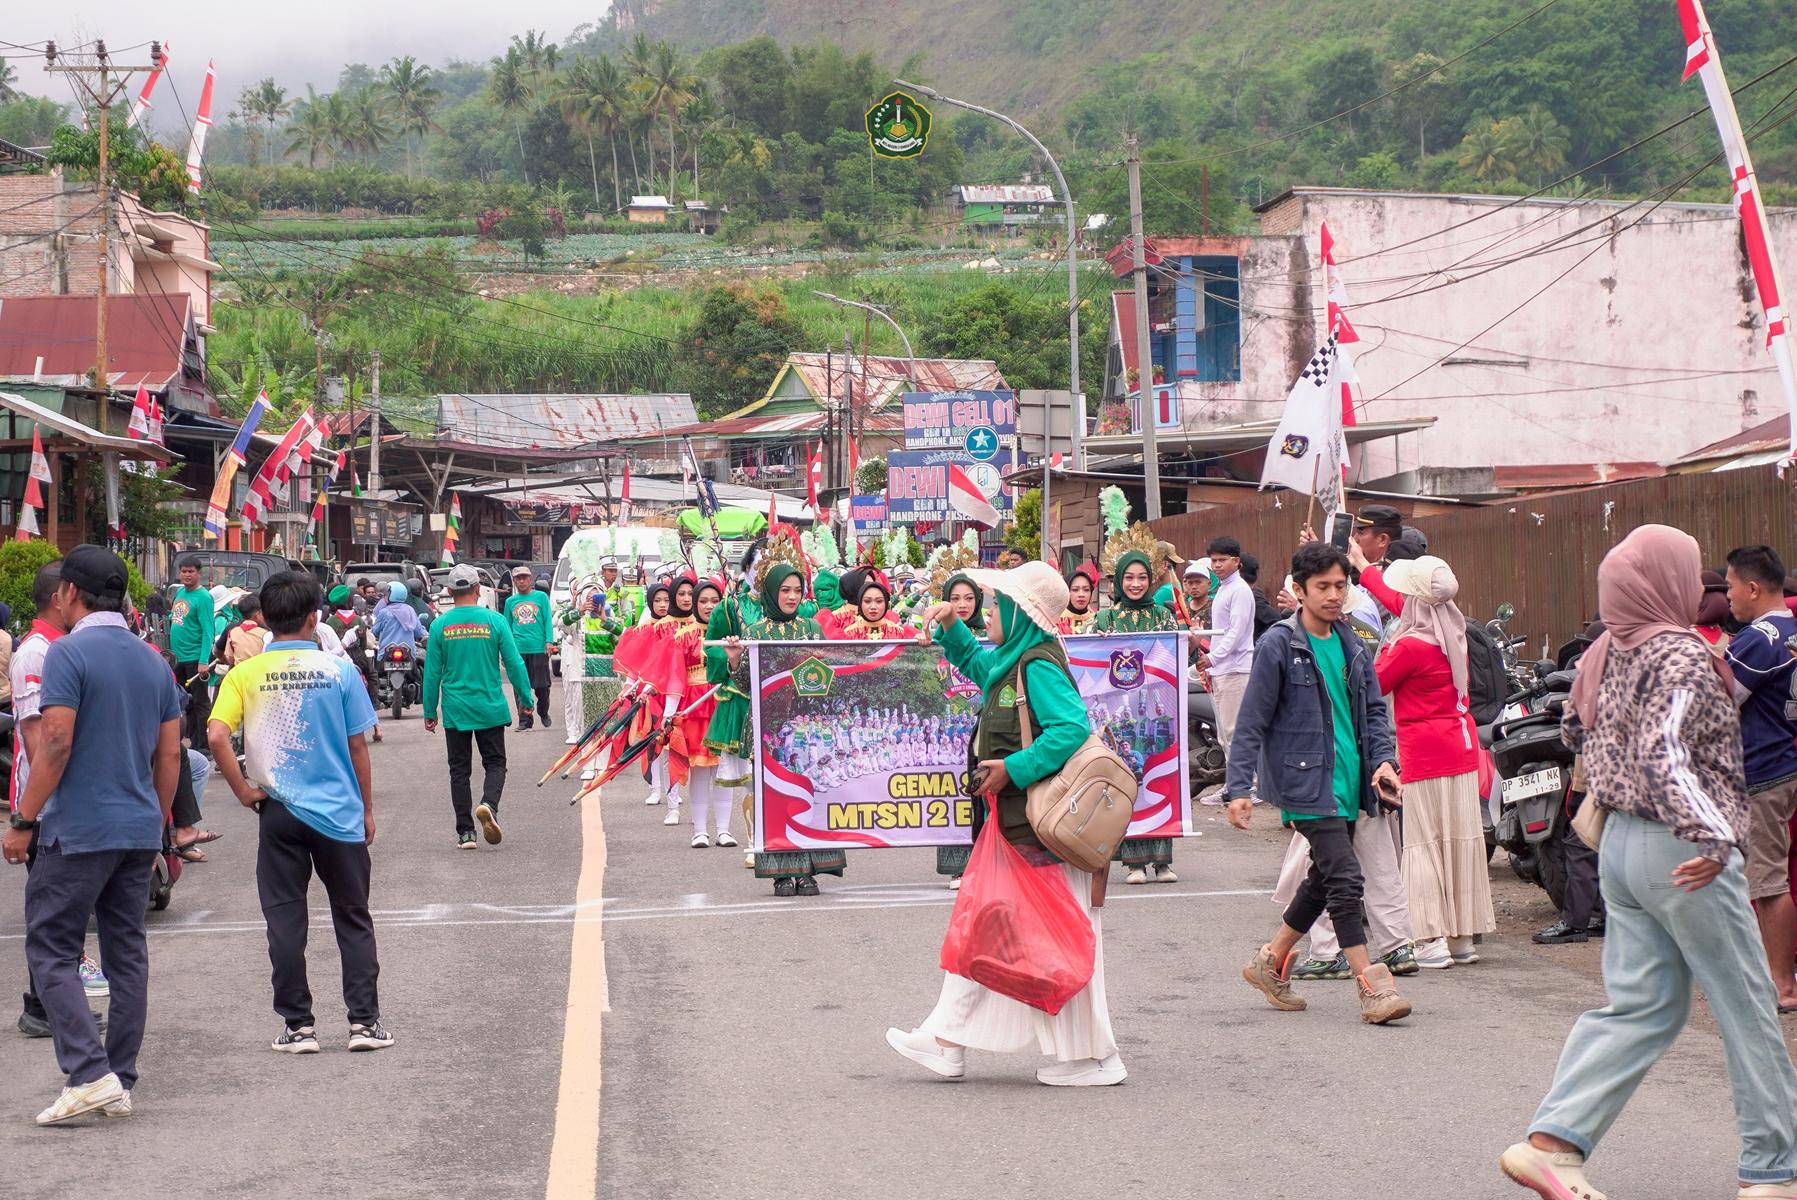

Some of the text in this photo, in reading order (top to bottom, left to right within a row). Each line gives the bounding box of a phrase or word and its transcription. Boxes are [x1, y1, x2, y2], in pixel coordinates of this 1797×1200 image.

[903, 398, 1014, 429] DEWI CELL 01
[906, 436, 948, 447] HANDPHONE
[888, 466, 946, 499] DEWI
[853, 505, 885, 521] DEWI
[890, 511, 942, 521] HANDPHONE
[443, 623, 491, 636] OFFICIAL
[265, 670, 325, 682] IGORNAS
[259, 684, 279, 692] KAB
[888, 771, 959, 799] GEMA
[1502, 768, 1559, 792] DP 3541 NK
[827, 800, 922, 830] MTSN
[927, 799, 949, 828] 2
